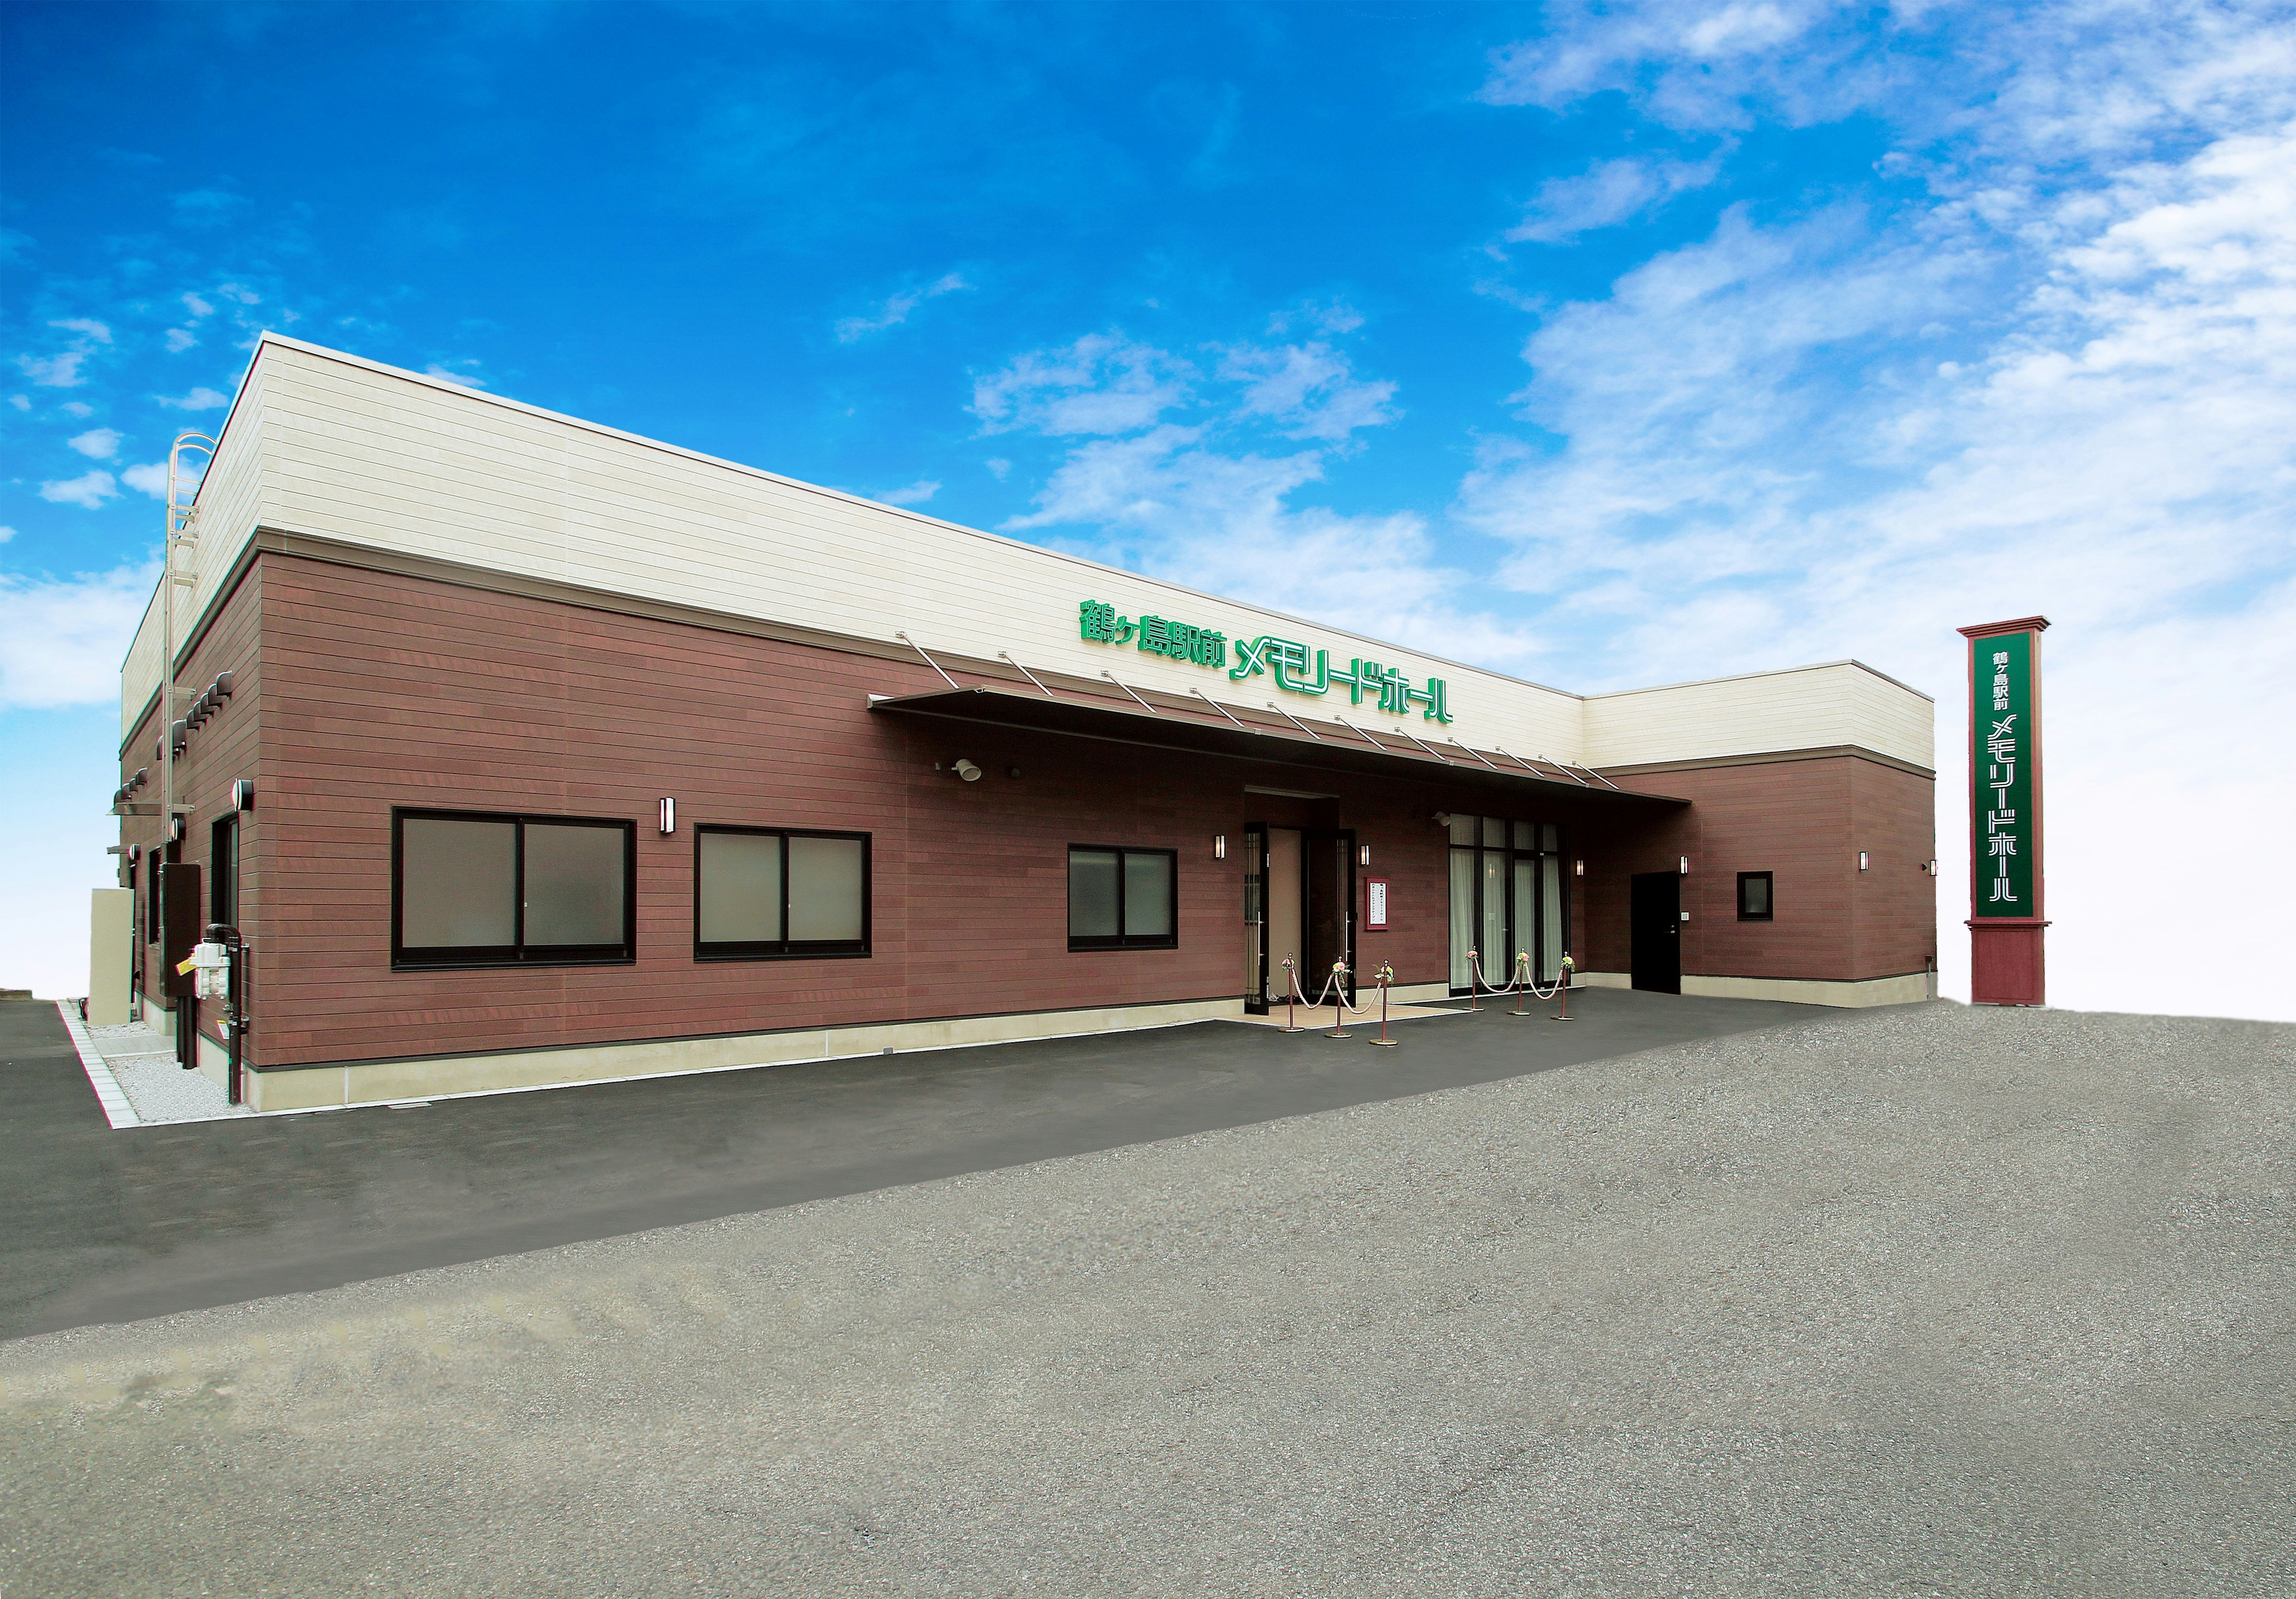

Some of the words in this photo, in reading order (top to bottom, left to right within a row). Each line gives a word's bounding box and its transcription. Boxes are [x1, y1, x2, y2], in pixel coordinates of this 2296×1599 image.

[1229, 636, 1453, 724] メモリードホール
[1987, 714, 2017, 902] メモリードホール
